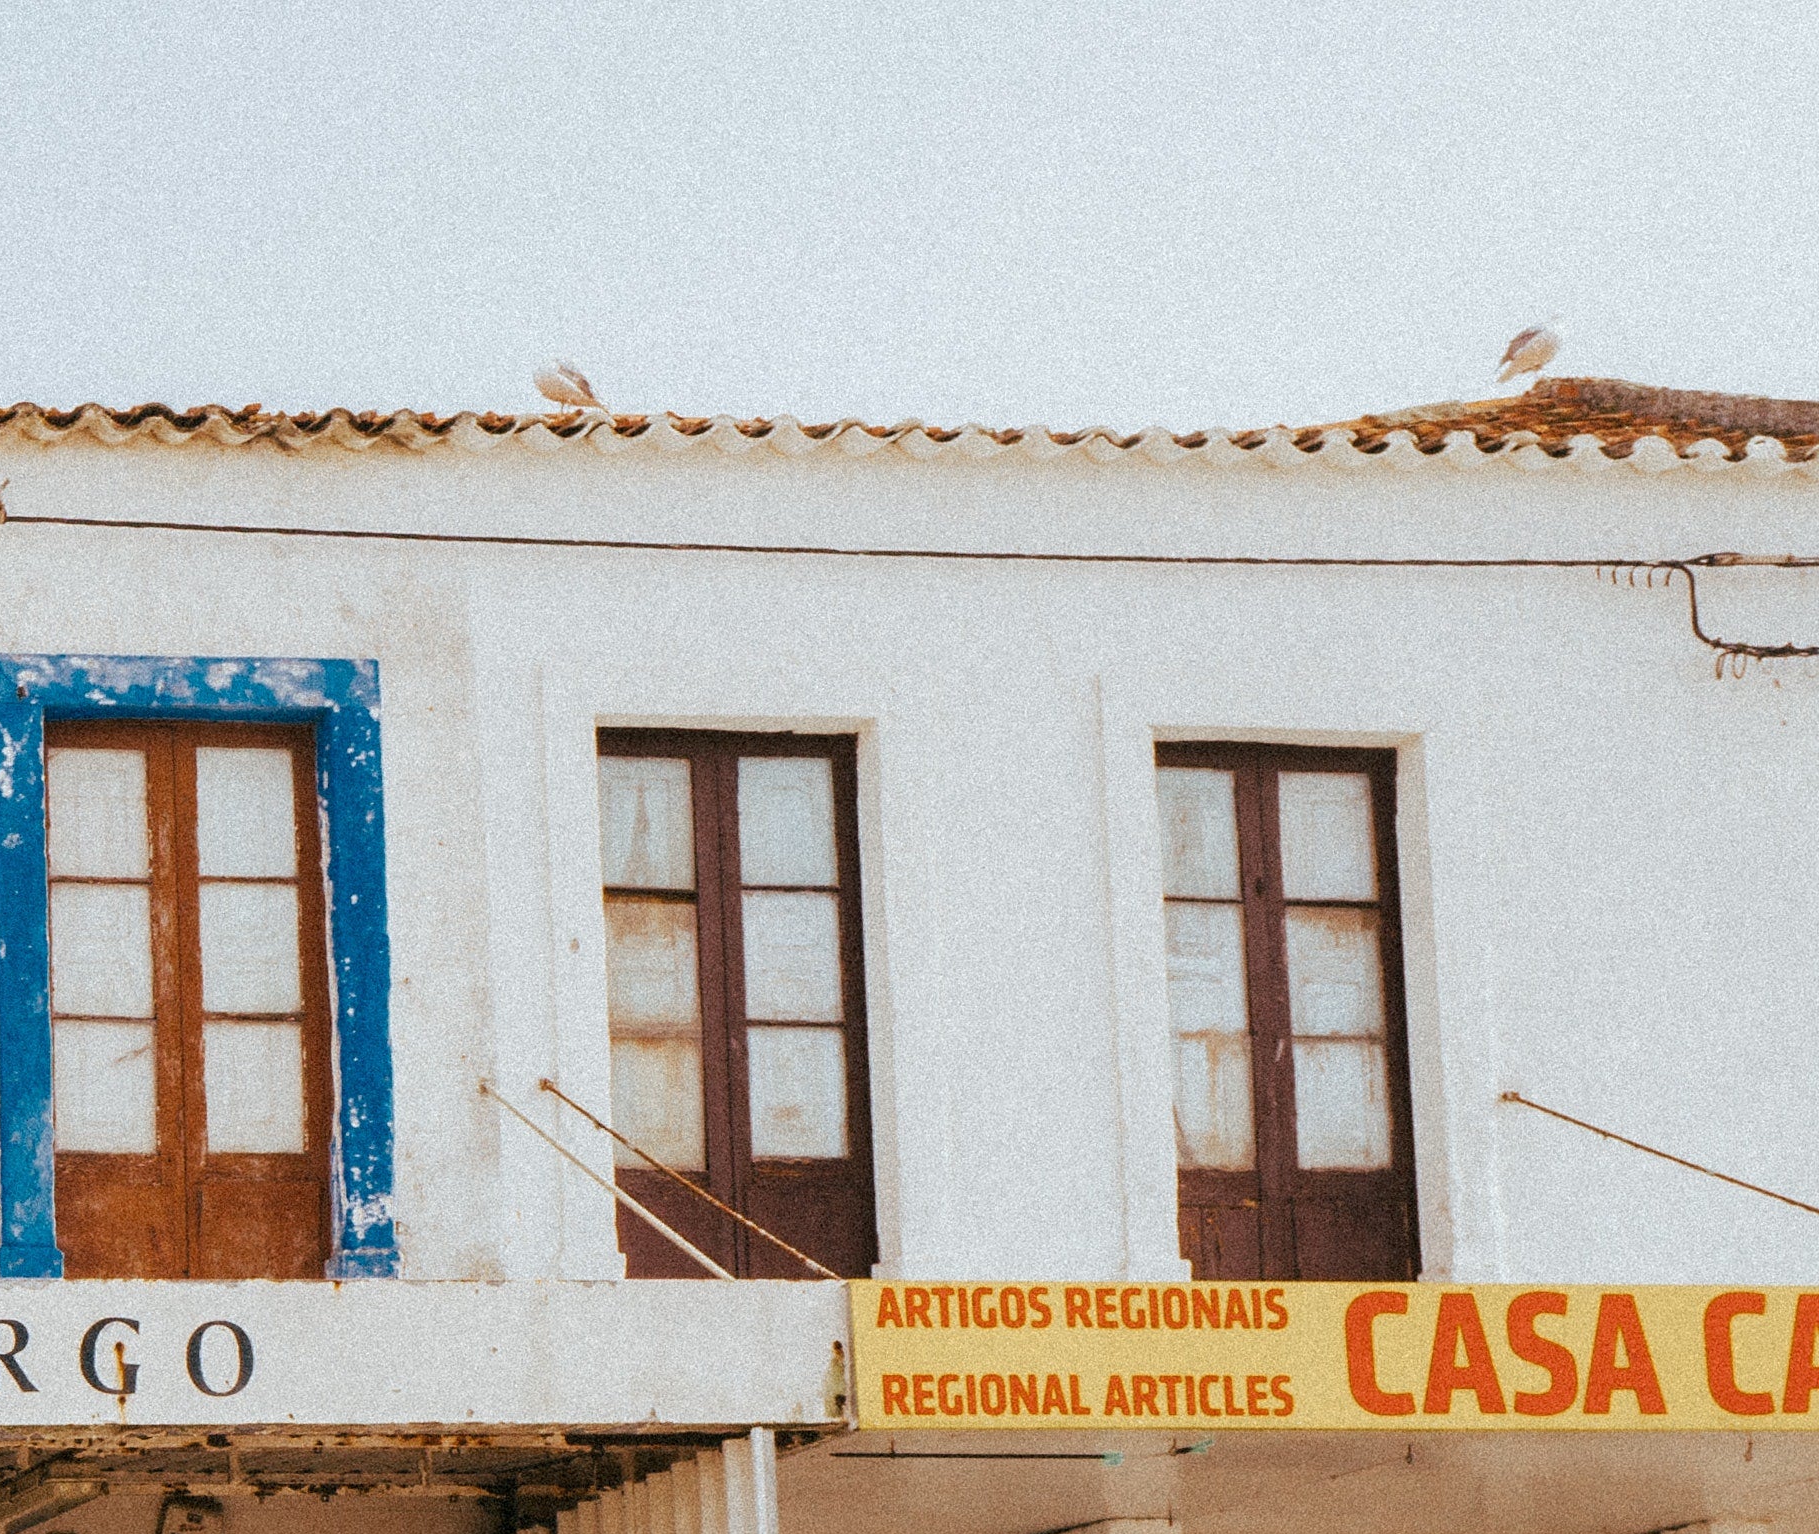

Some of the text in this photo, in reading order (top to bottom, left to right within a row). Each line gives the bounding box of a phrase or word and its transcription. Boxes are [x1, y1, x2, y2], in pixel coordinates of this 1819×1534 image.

[877, 1287, 1288, 1330] ARTIGOS REGIONAIS
[1344, 1290, 1668, 1416] CASA
[882, 1374, 1294, 1417] REGIONAL ARTICLES
